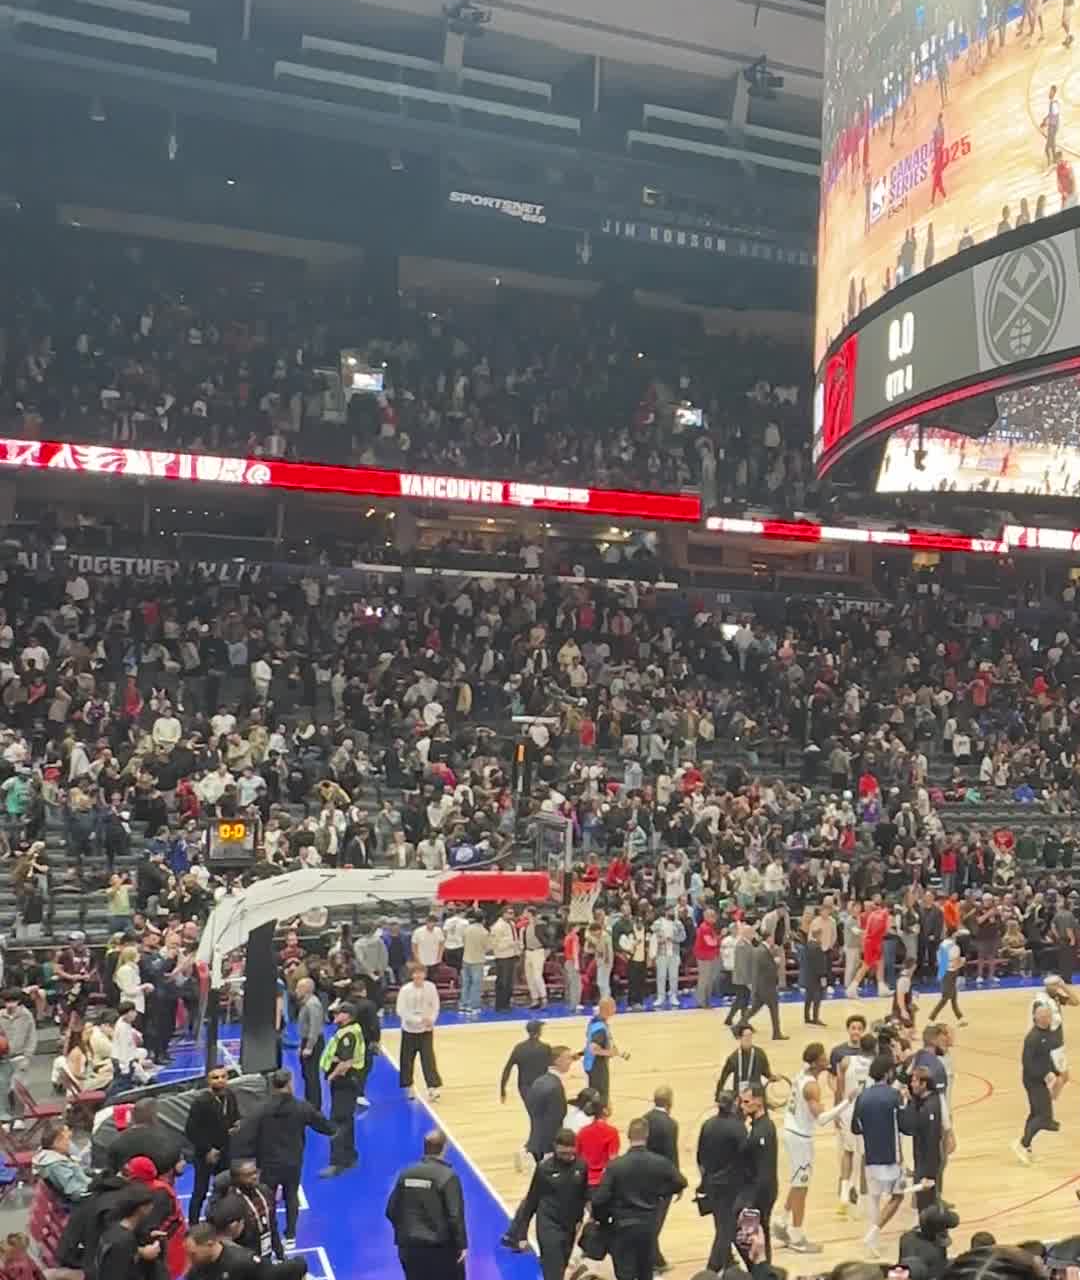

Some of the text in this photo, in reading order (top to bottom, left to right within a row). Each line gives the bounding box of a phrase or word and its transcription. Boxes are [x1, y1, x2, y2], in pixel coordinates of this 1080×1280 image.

[449, 191, 545, 217] SPORTSNET
[602, 219, 636, 238] JIM
[400, 473, 503, 503] VANCOUVER
